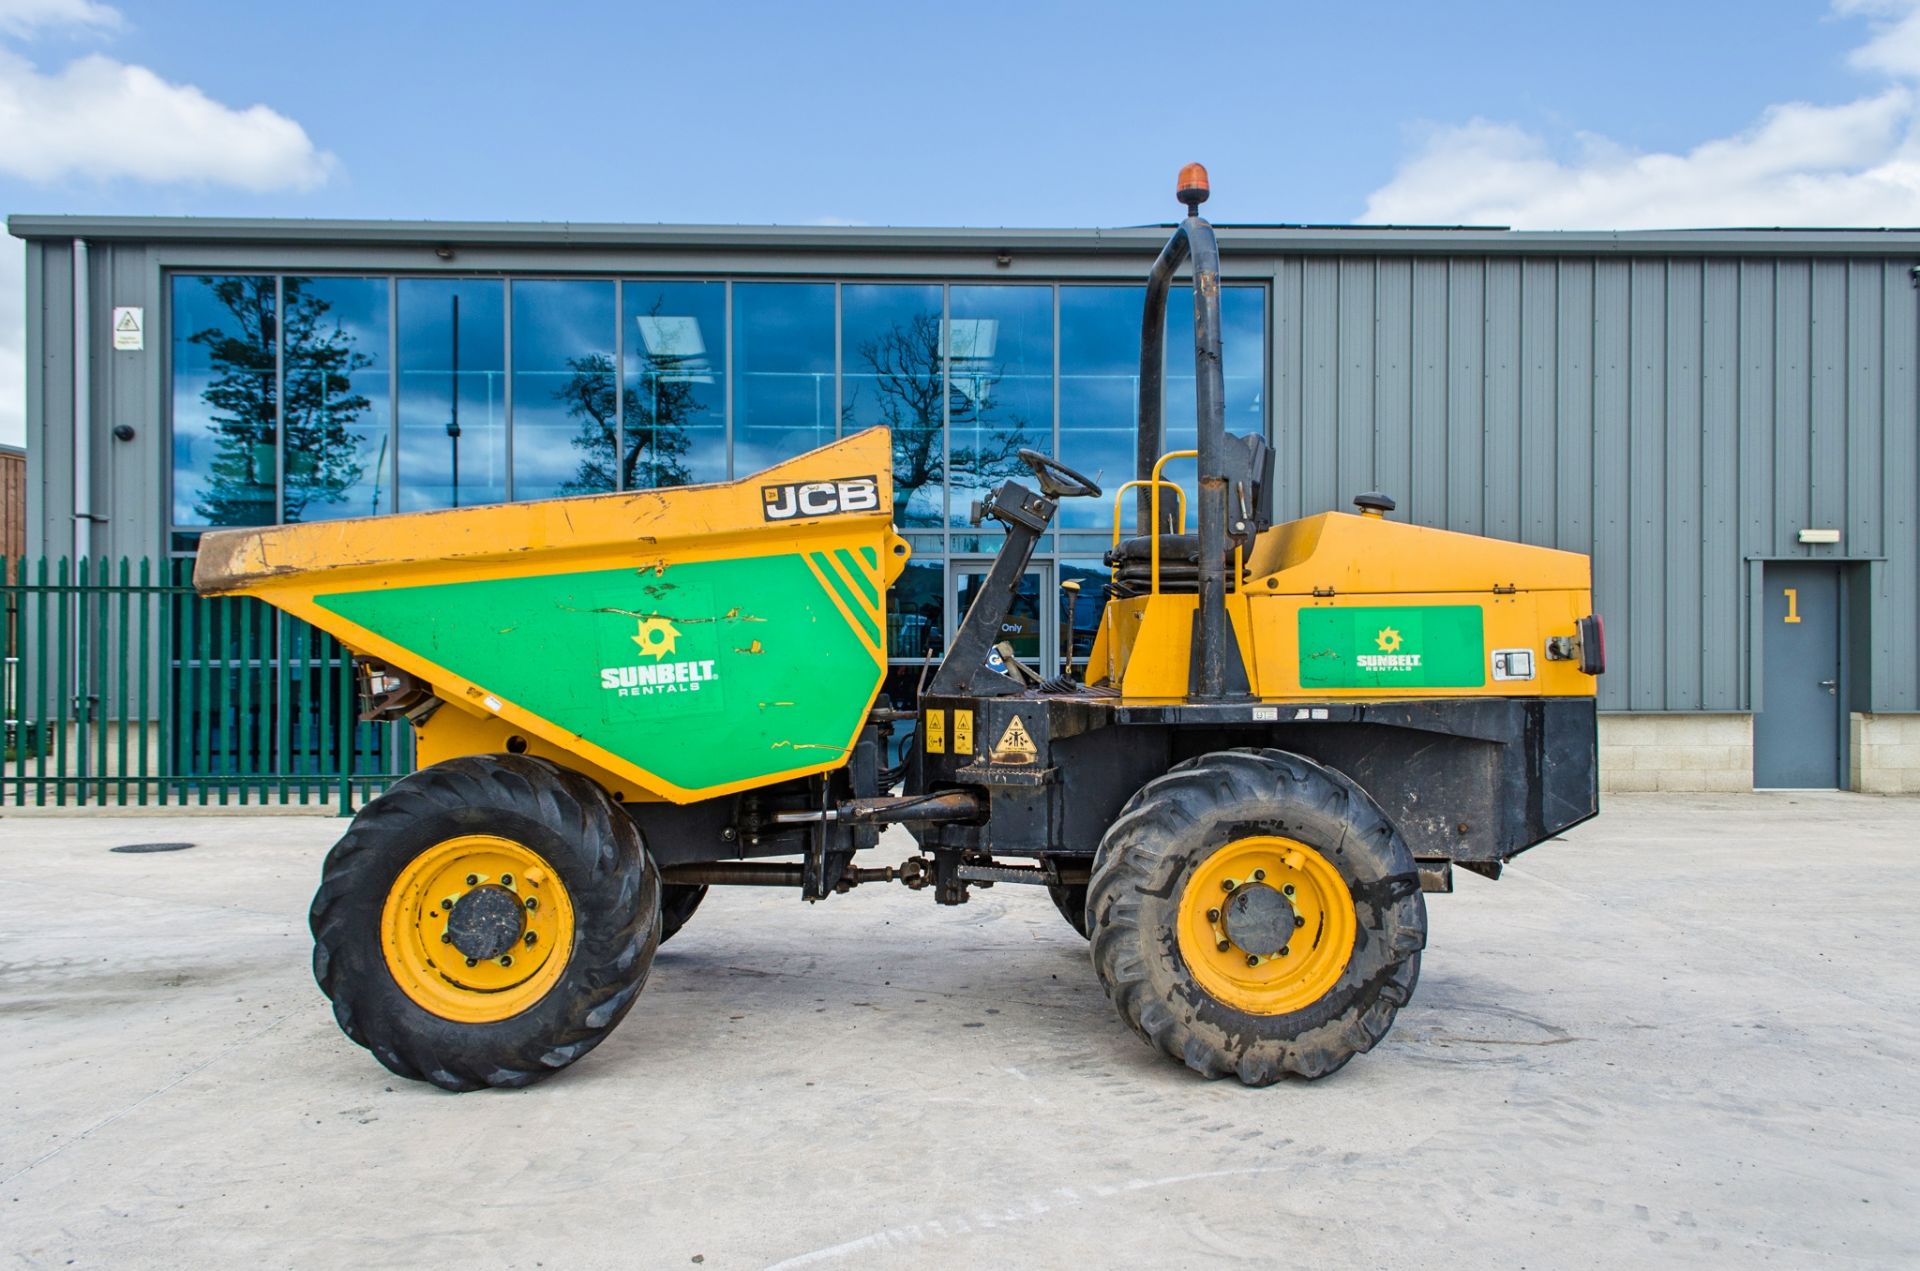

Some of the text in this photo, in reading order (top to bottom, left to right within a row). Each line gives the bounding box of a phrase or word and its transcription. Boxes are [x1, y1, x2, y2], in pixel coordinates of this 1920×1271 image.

[764, 479, 878, 519] JCB
[1784, 588, 1801, 623] 1
[1001, 623, 1022, 634] Only
[1356, 654, 1421, 667] SUNBELT
[600, 660, 716, 690] SUNBELT
[618, 682, 700, 697] RENTALS
